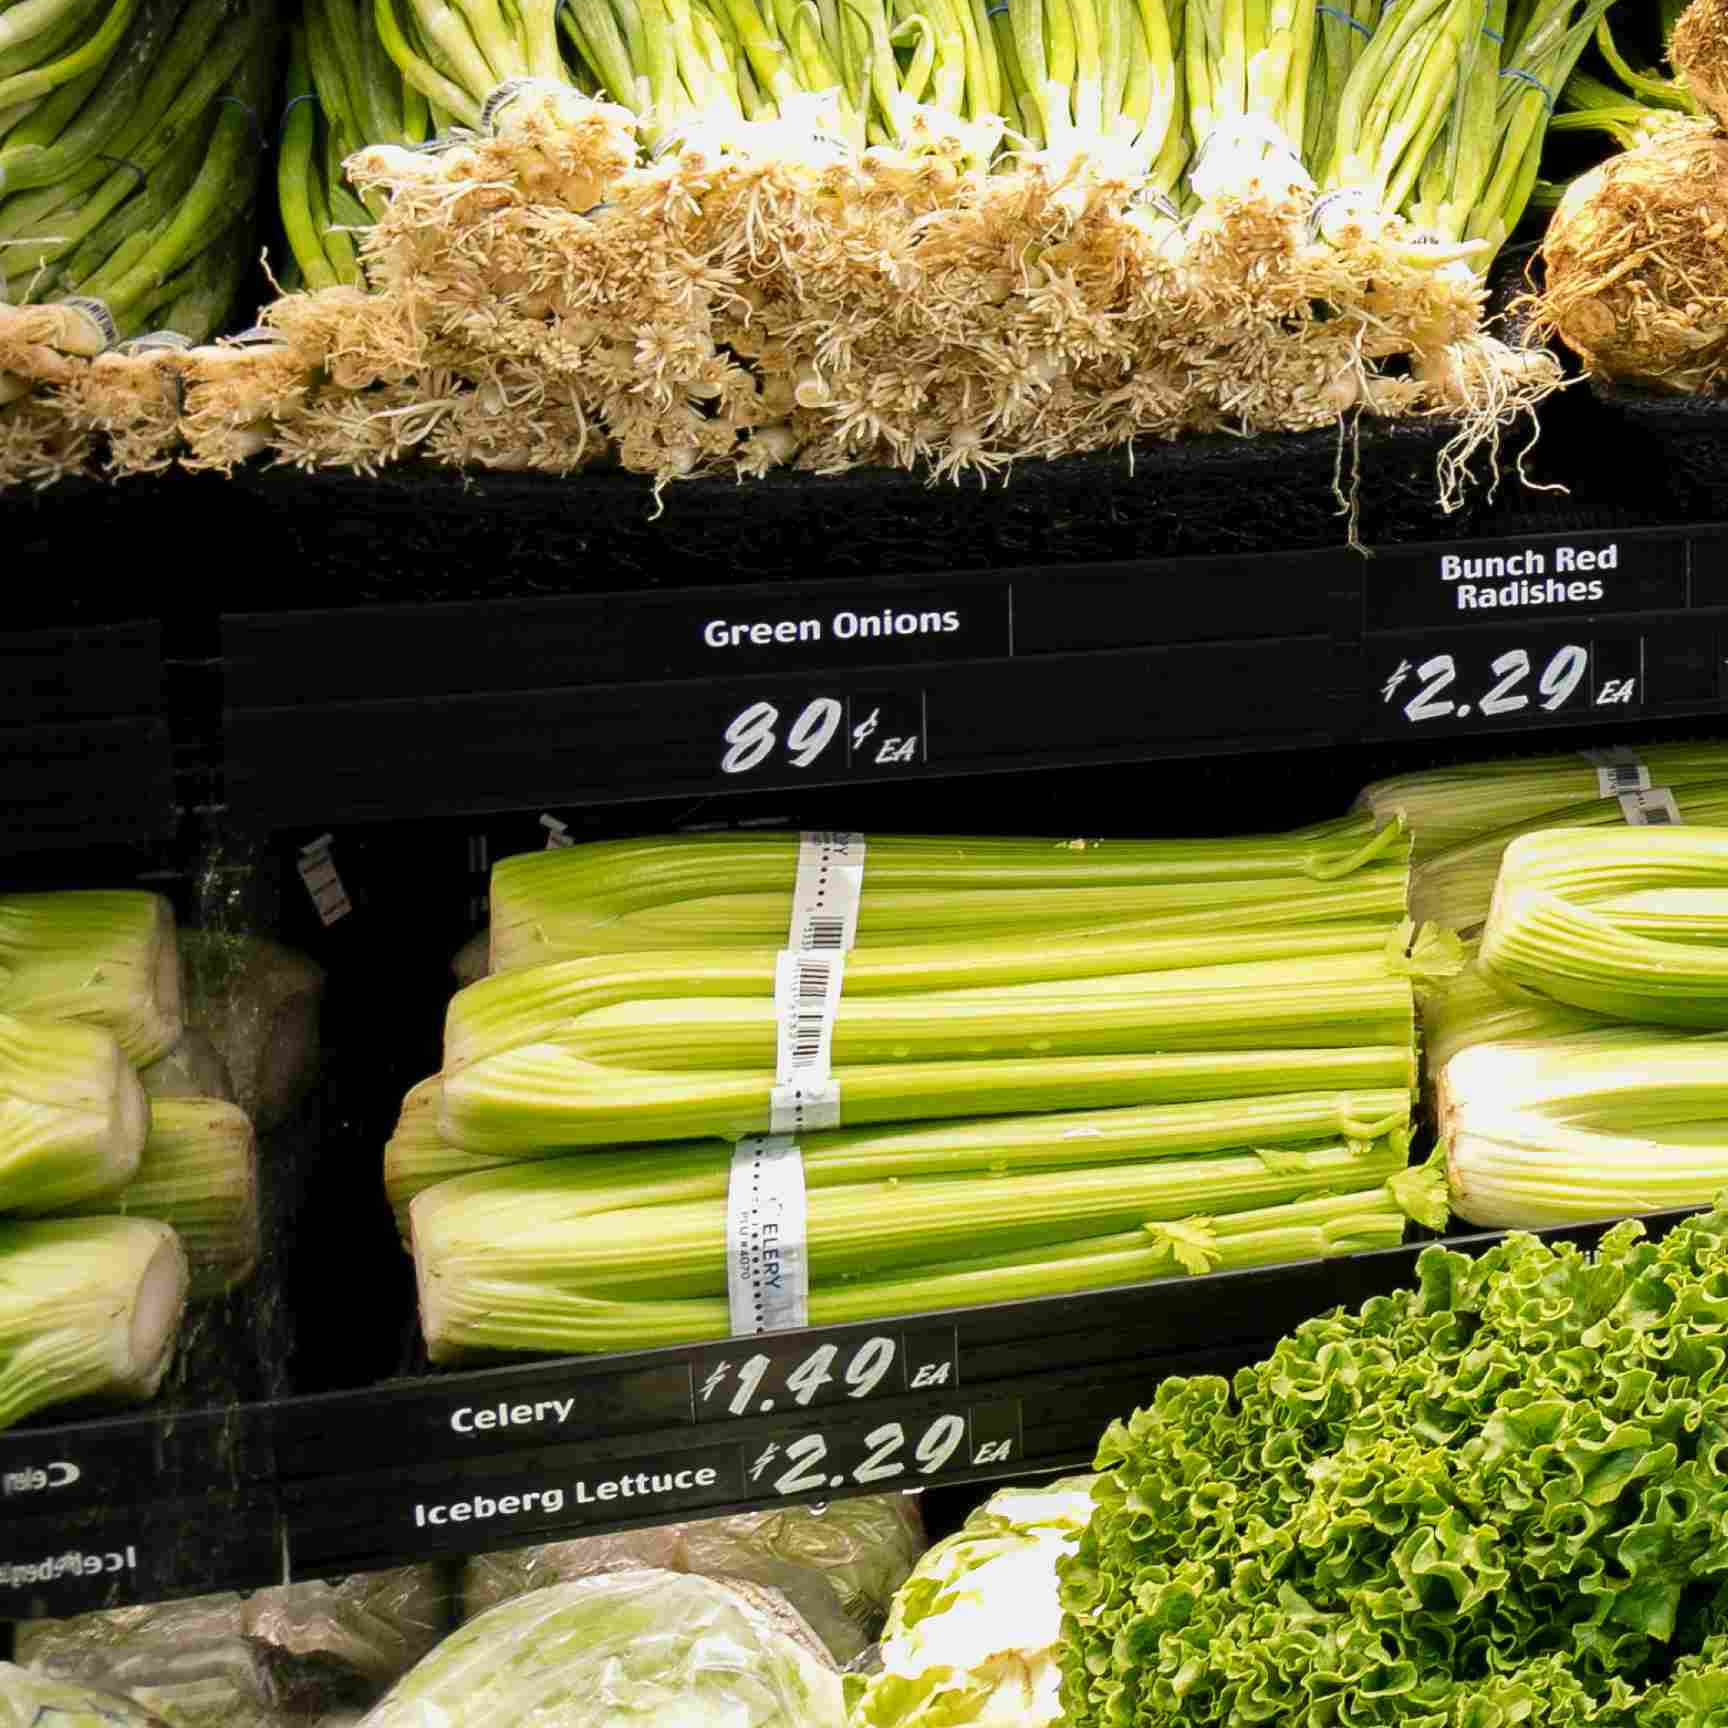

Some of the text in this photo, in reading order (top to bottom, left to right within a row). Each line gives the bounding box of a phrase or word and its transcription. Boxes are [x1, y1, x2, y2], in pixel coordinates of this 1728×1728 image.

[1441, 543, 1618, 581] Bunch Red
[1458, 579, 1603, 609] Radishes
[704, 609, 960, 647] Green Onions
[1381, 645, 1587, 722] $2.29
[699, 1337, 895, 1415] $1.49
[451, 1398, 574, 1432] Celery
[749, 1415, 964, 1495] $2.29
[416, 1468, 716, 1526] Iceberg Lettuce
